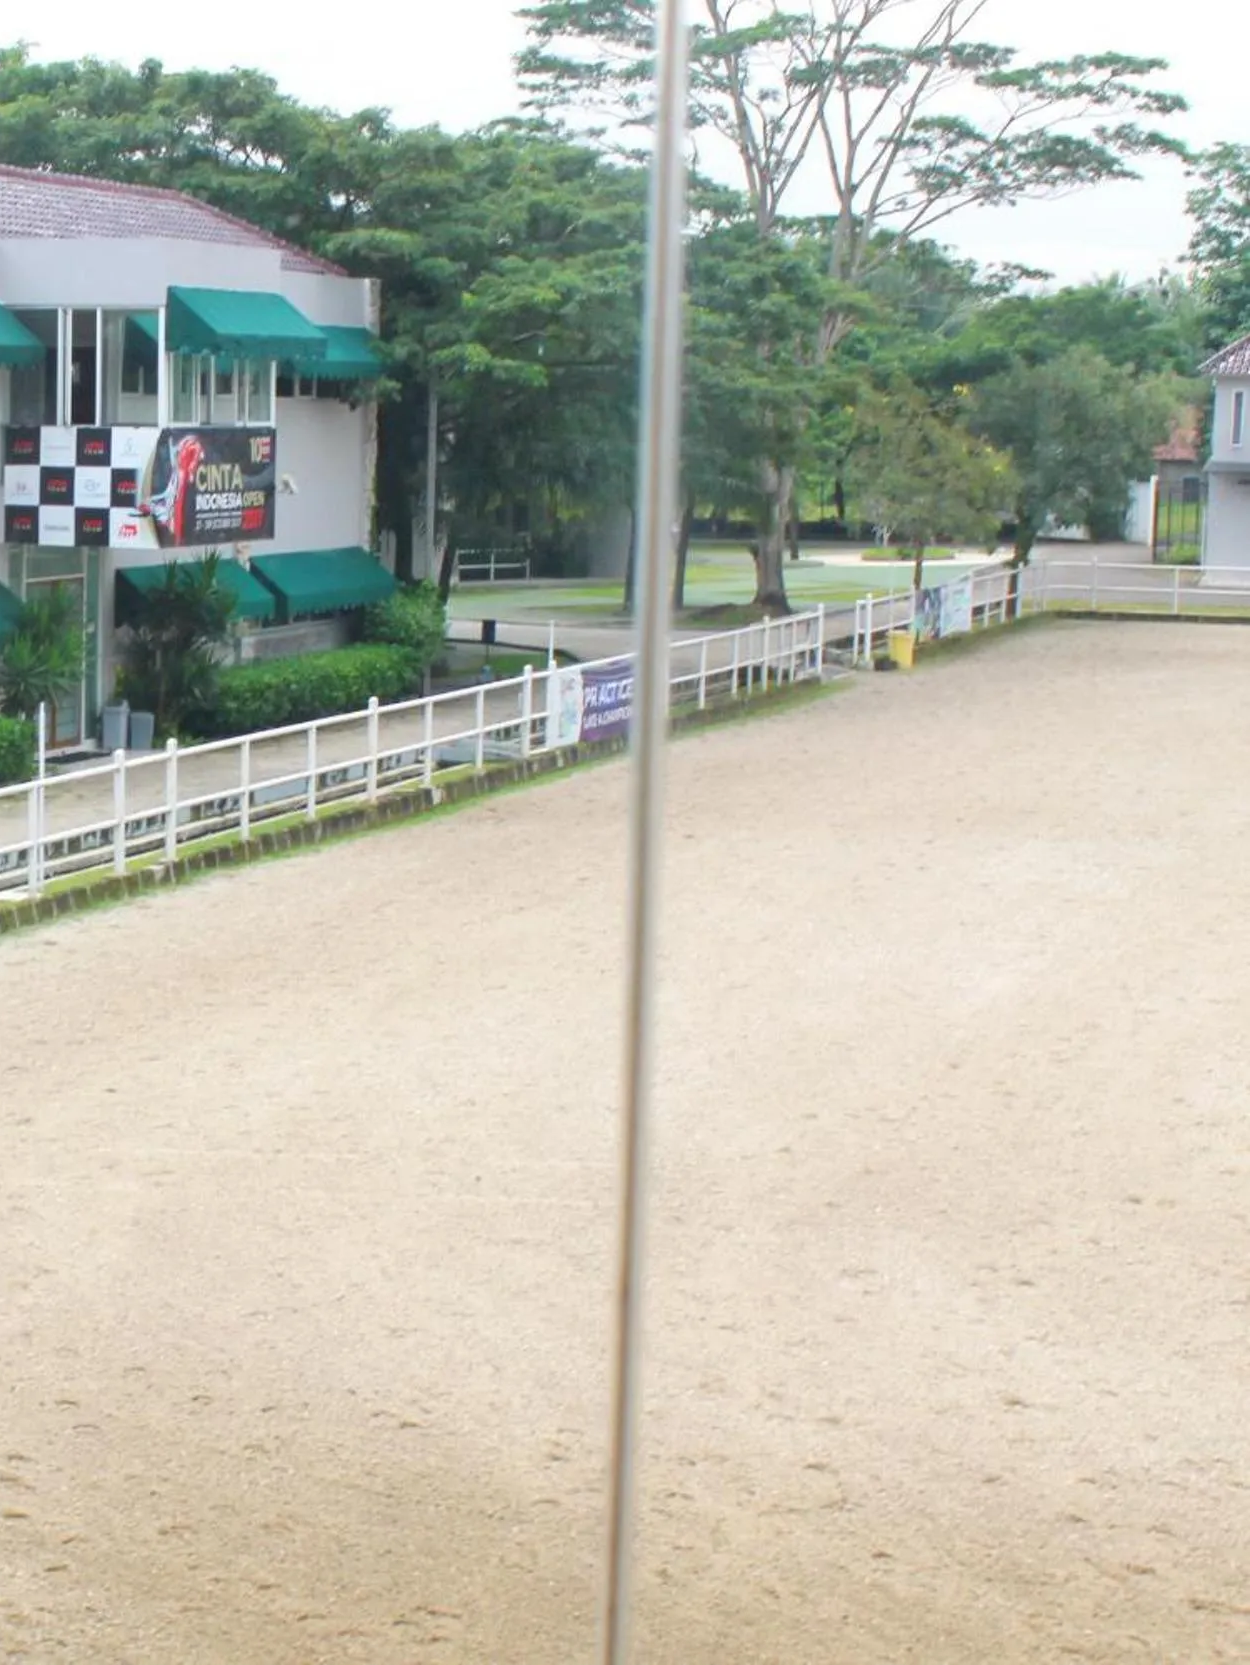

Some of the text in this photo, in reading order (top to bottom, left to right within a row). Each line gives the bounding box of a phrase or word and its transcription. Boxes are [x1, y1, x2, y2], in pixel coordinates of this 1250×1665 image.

[196, 463, 243, 492] CINTA
[196, 491, 266, 512] INDONESIA OPEN
